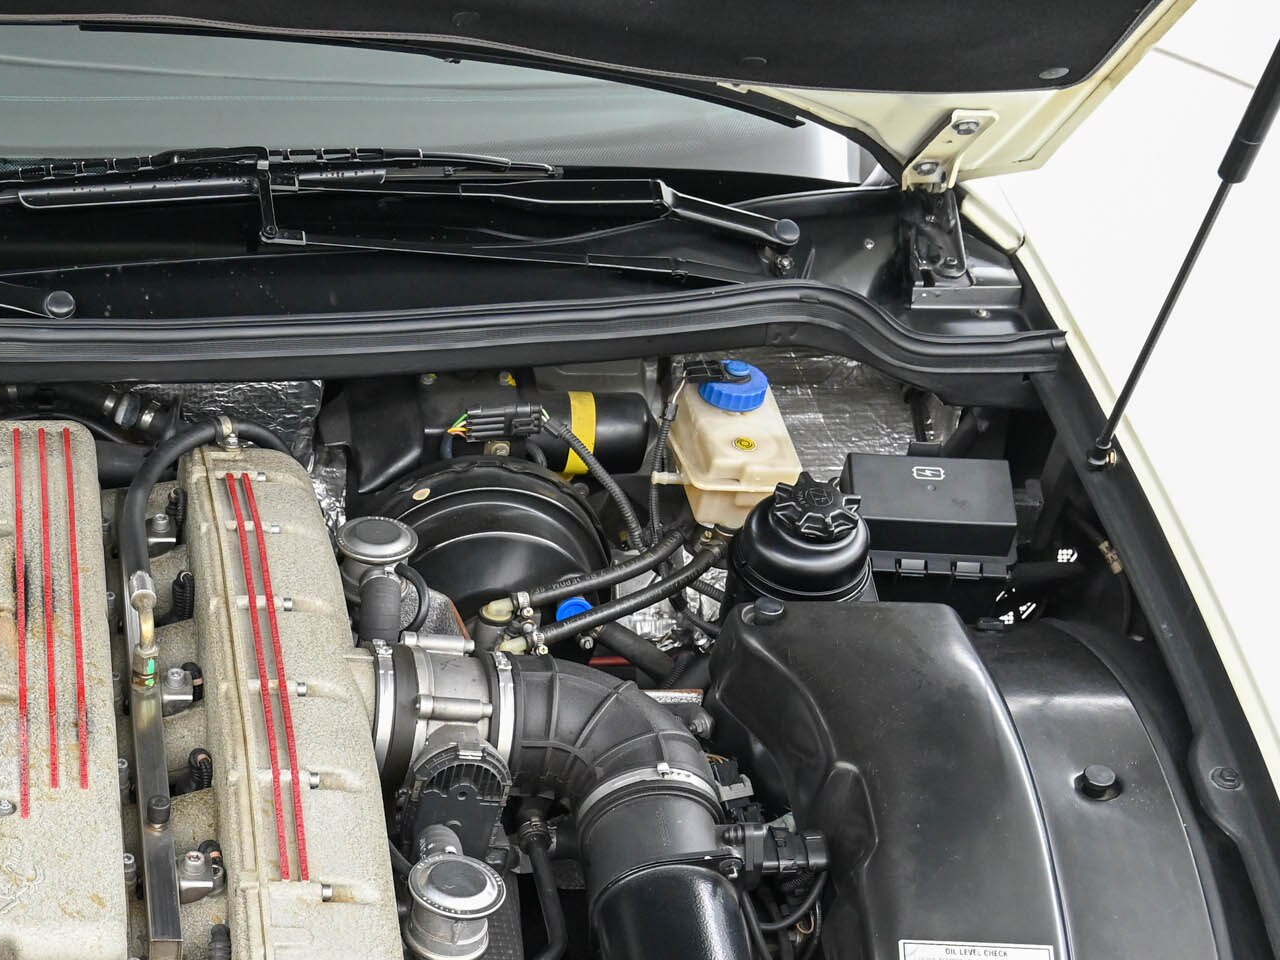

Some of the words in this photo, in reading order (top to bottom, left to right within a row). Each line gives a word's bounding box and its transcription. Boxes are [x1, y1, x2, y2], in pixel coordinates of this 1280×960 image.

[945, 948, 957, 956] OIL
[960, 949, 982, 957] LEVEL
[983, 949, 1008, 958] CHECK
